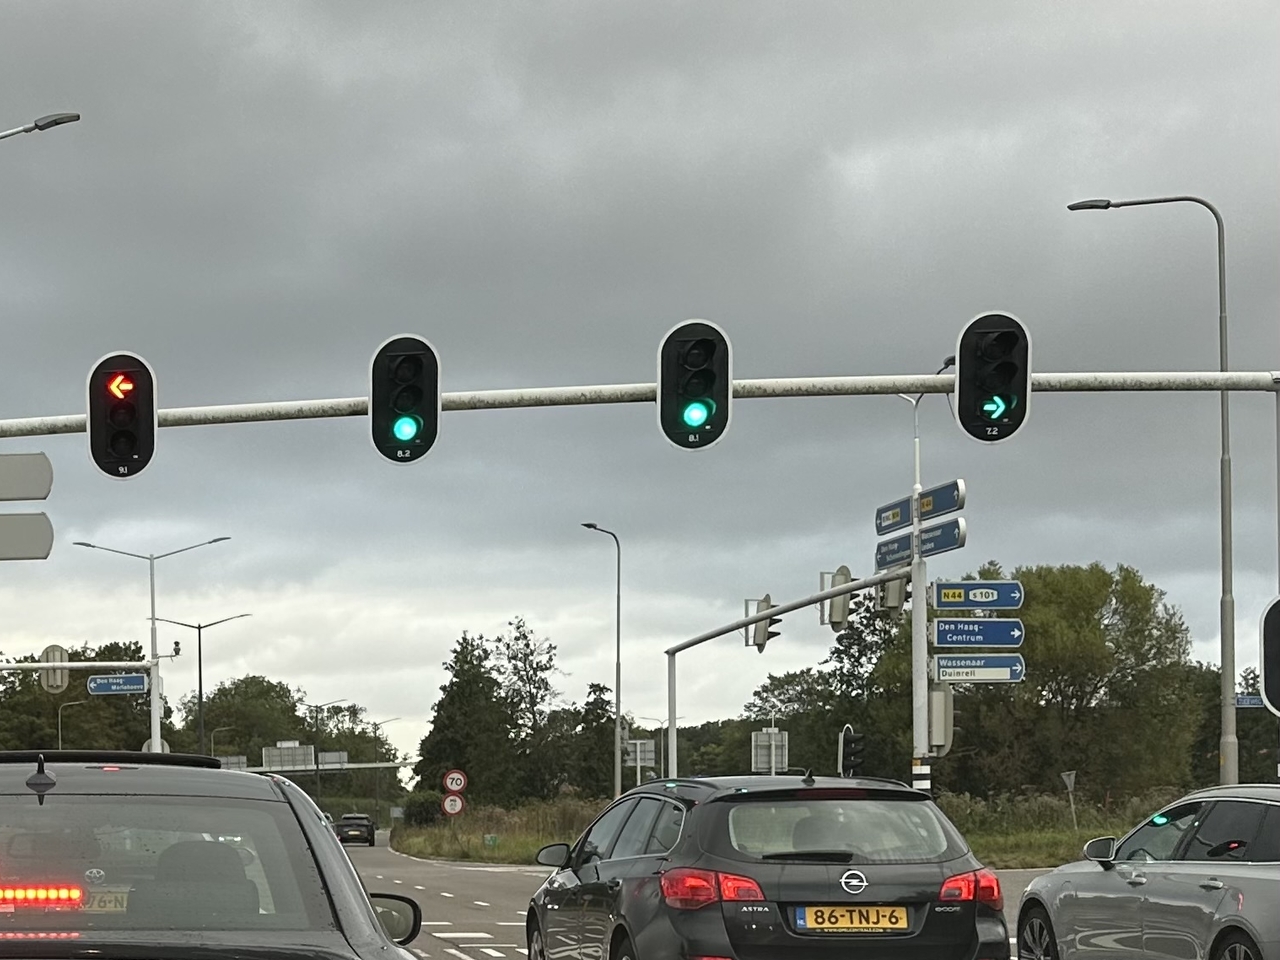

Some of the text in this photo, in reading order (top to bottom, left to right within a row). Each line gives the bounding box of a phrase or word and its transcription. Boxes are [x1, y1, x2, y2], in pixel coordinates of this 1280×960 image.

[396, 449, 411, 458] 8.2
[939, 623, 983, 632] Den Haag-
[947, 634, 983, 642] Centrum
[939, 659, 985, 667] Wassenaar
[941, 669, 976, 678] Duinrell
[449, 777, 463, 787] 70
[813, 909, 900, 925] 86-TNJ-6
